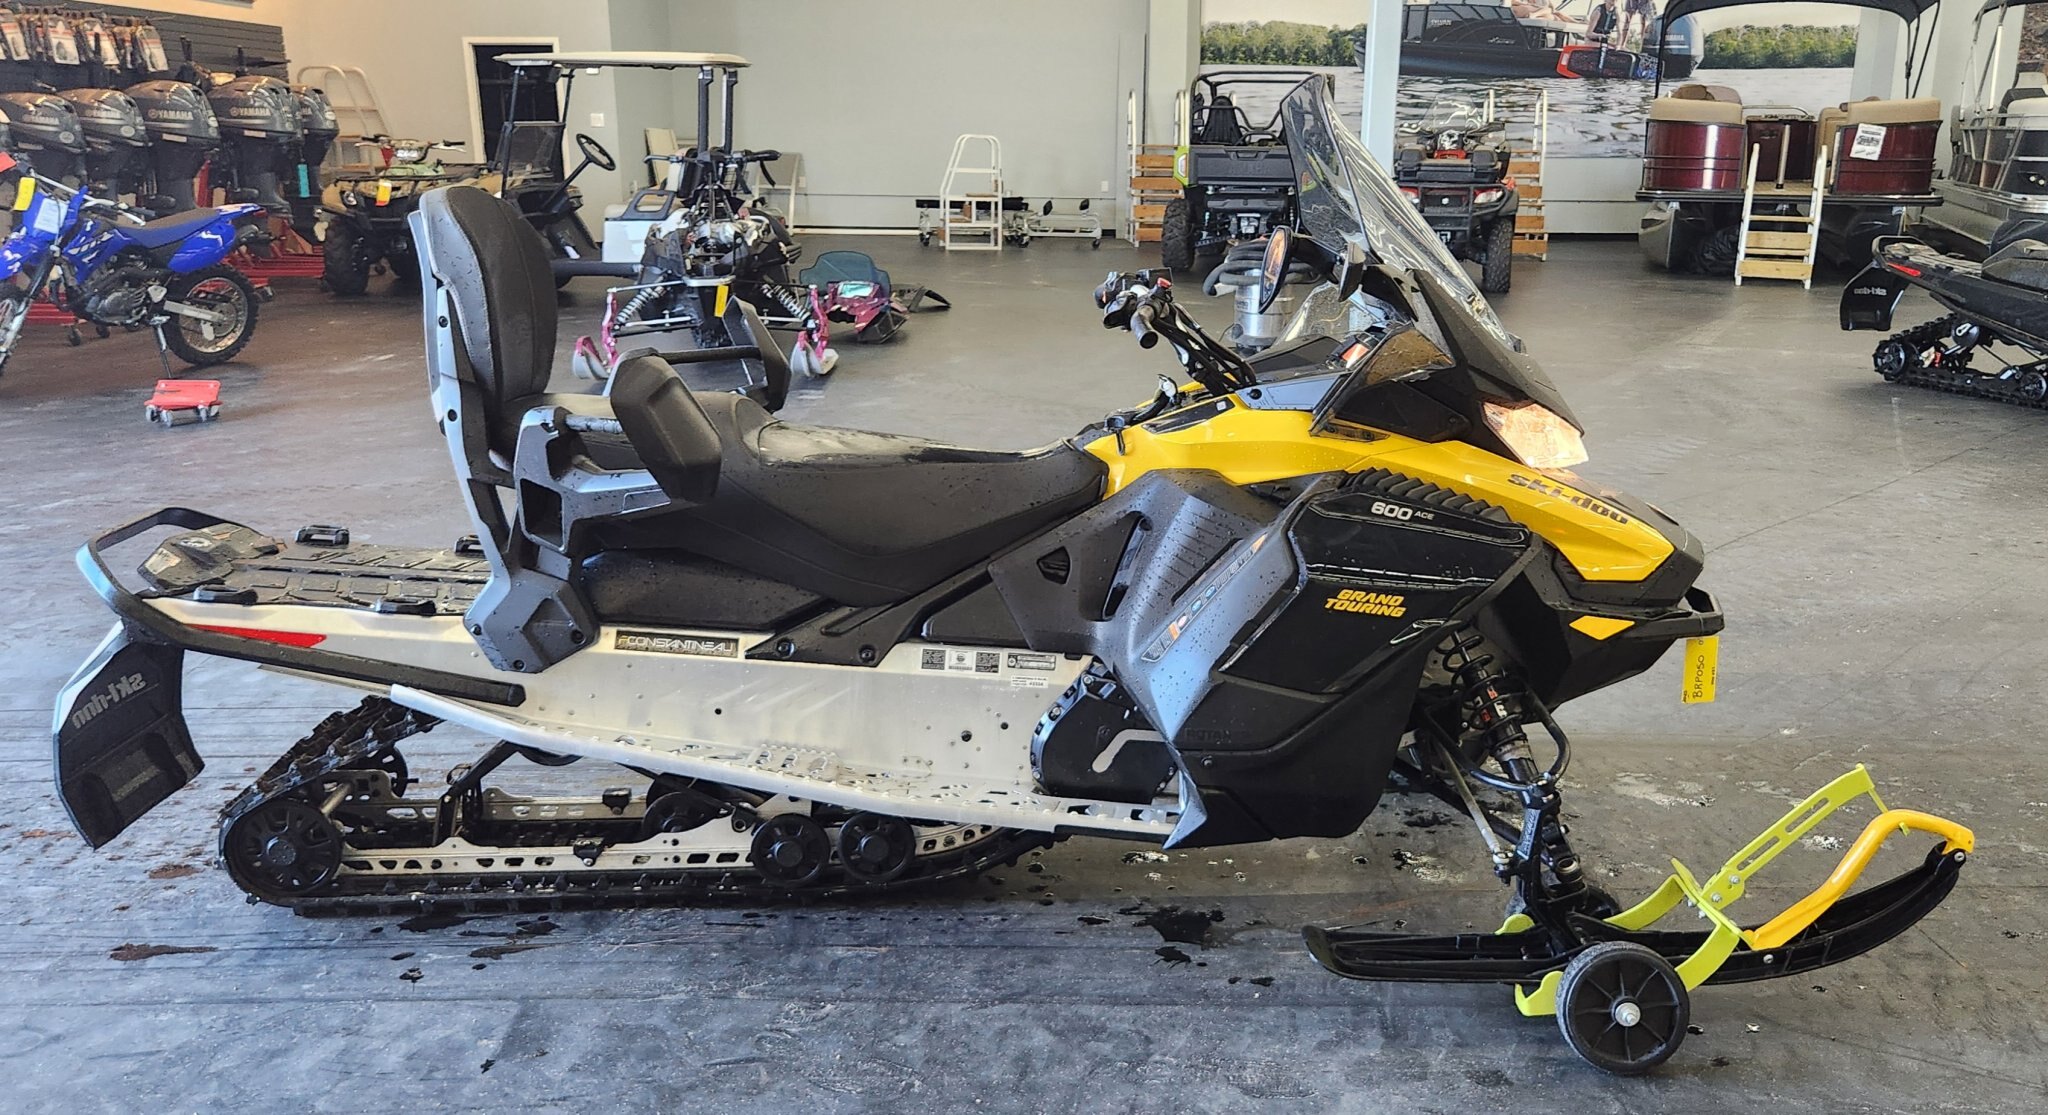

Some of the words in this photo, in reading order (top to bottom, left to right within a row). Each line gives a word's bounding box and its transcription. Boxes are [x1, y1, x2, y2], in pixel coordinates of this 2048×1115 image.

[158, 109, 194, 121] YAMAHA
[238, 106, 271, 117] YAMAHA
[1371, 501, 1414, 521] 600
[1414, 510, 1436, 521] ACE
[1336, 588, 1405, 607] GRAND
[1324, 597, 1407, 618] TOURING
